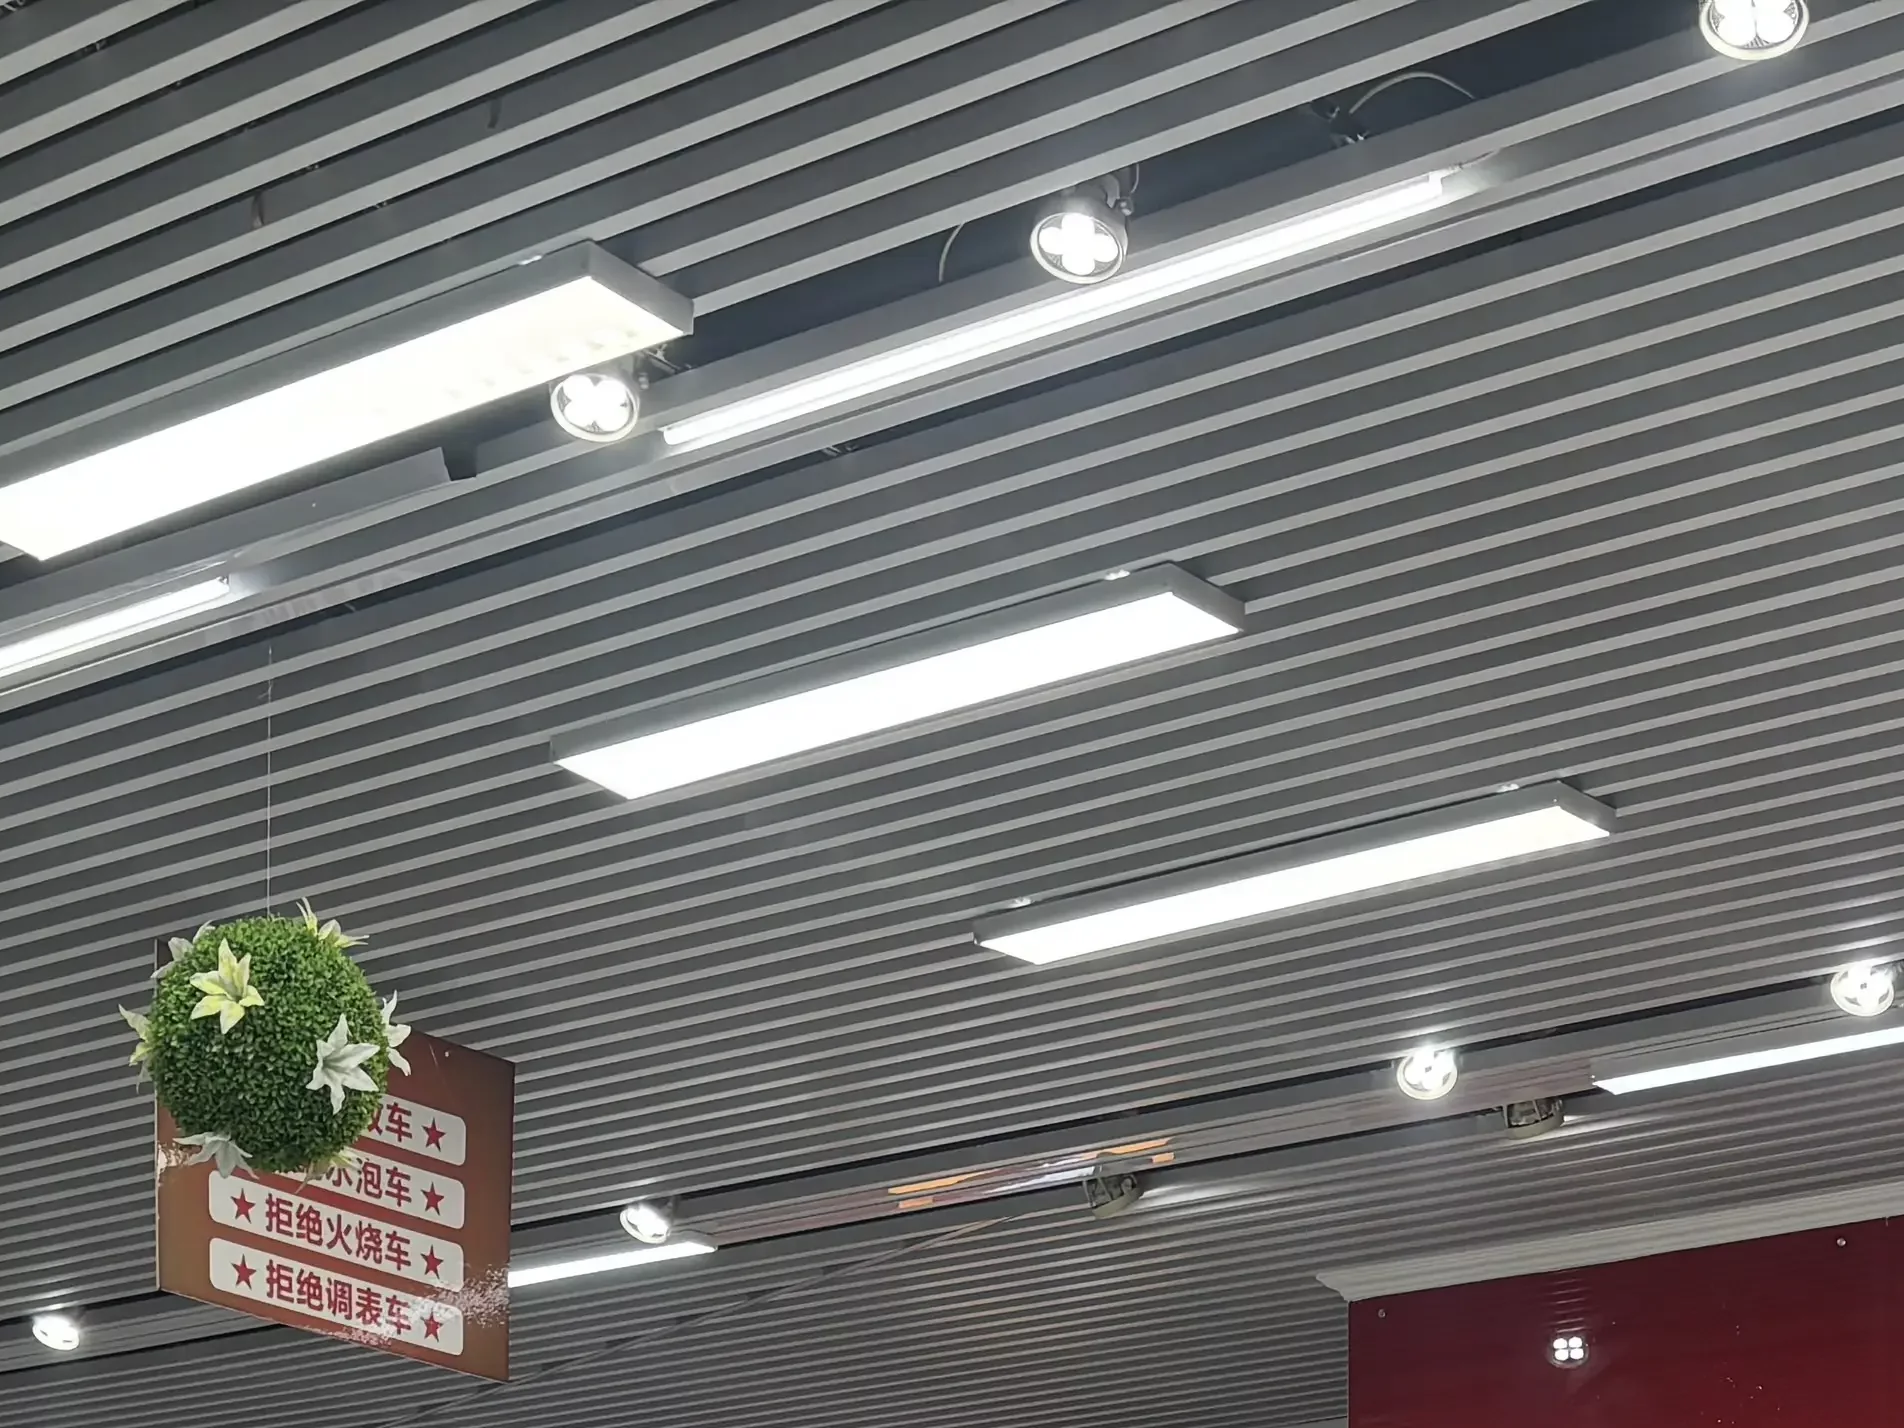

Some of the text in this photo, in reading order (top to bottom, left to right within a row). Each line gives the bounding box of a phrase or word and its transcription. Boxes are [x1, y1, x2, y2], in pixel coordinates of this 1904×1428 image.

[265, 1193, 412, 1272] 拒绝火烧车
[265, 1259, 412, 1336] 拒绝调表车
